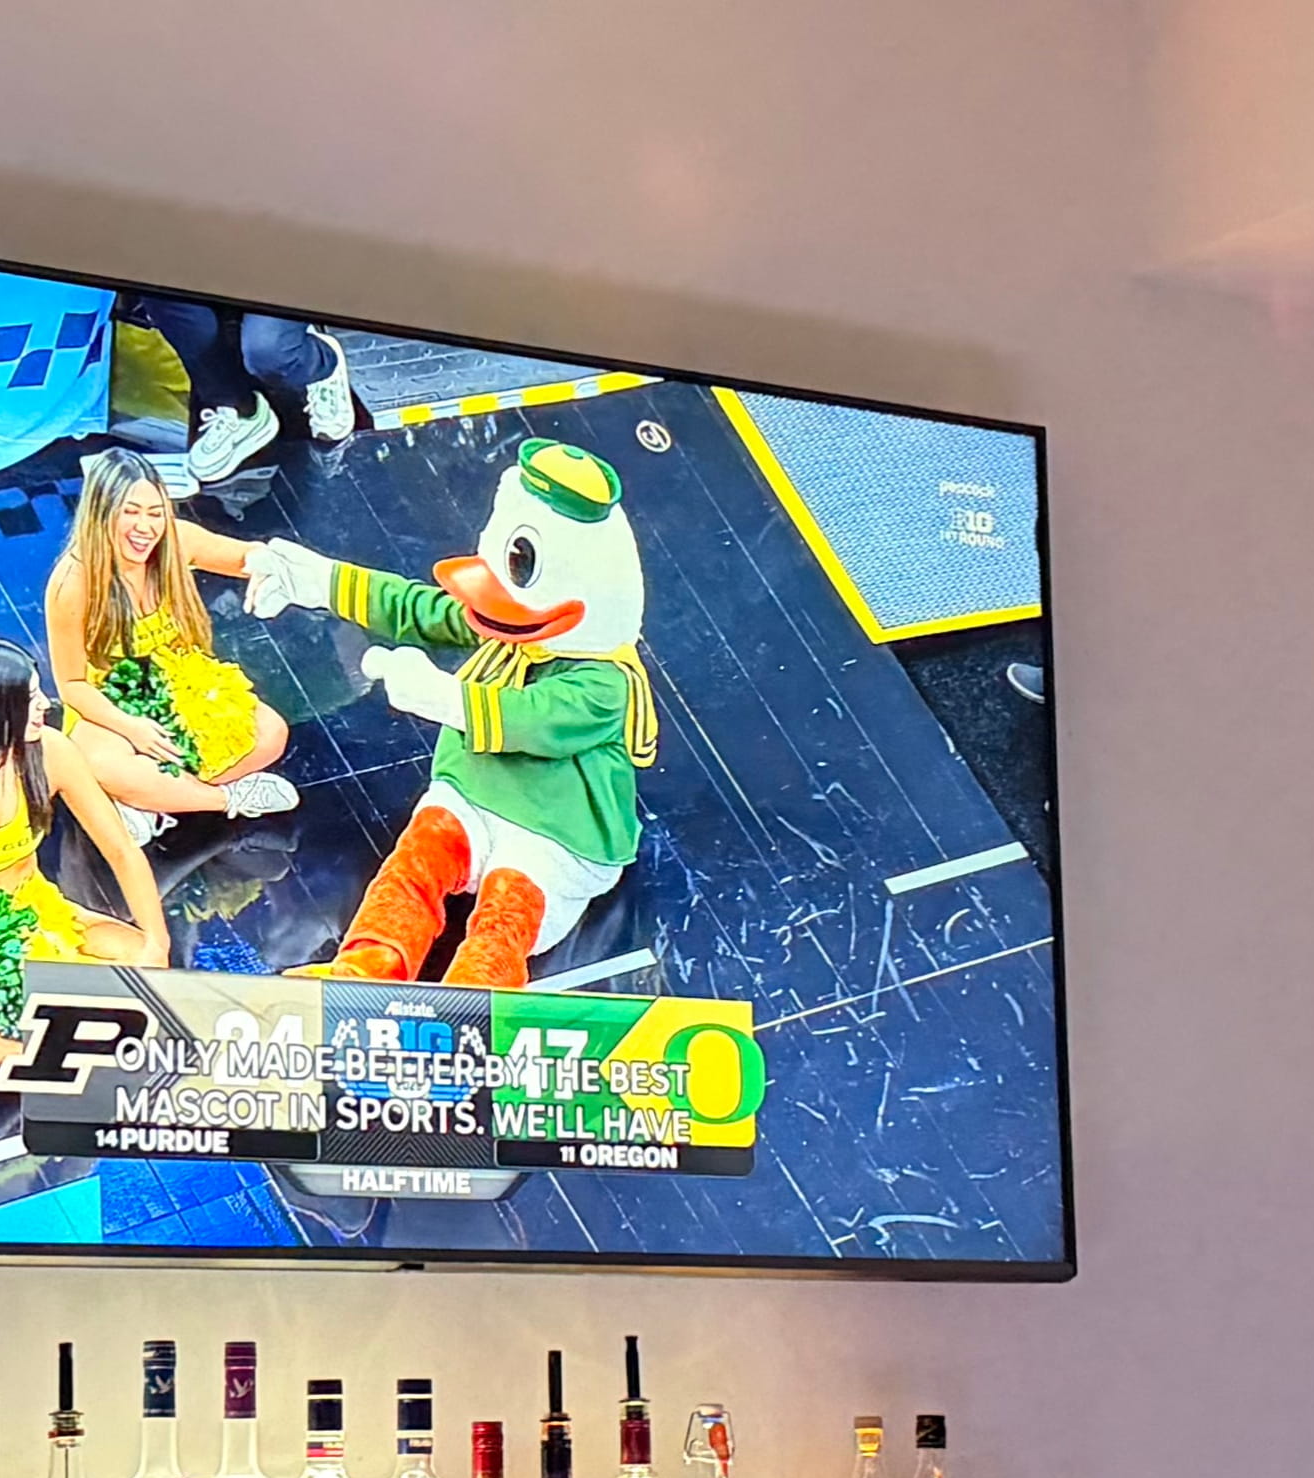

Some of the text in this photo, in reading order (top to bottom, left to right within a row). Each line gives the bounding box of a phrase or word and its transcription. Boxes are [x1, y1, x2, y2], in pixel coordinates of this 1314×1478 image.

[114, 1037, 691, 1096] ONLY MADE BETTER BY THE BEST
[505, 1026, 590, 1100] 47
[115, 1087, 691, 1142] MASCOT IN SPORTS. WE'LL HAVE
[95, 1127, 230, 1154] 14 PURDUE
[559, 1144, 678, 1168] 11 OREGON
[342, 1169, 471, 1194] HALFTIME
